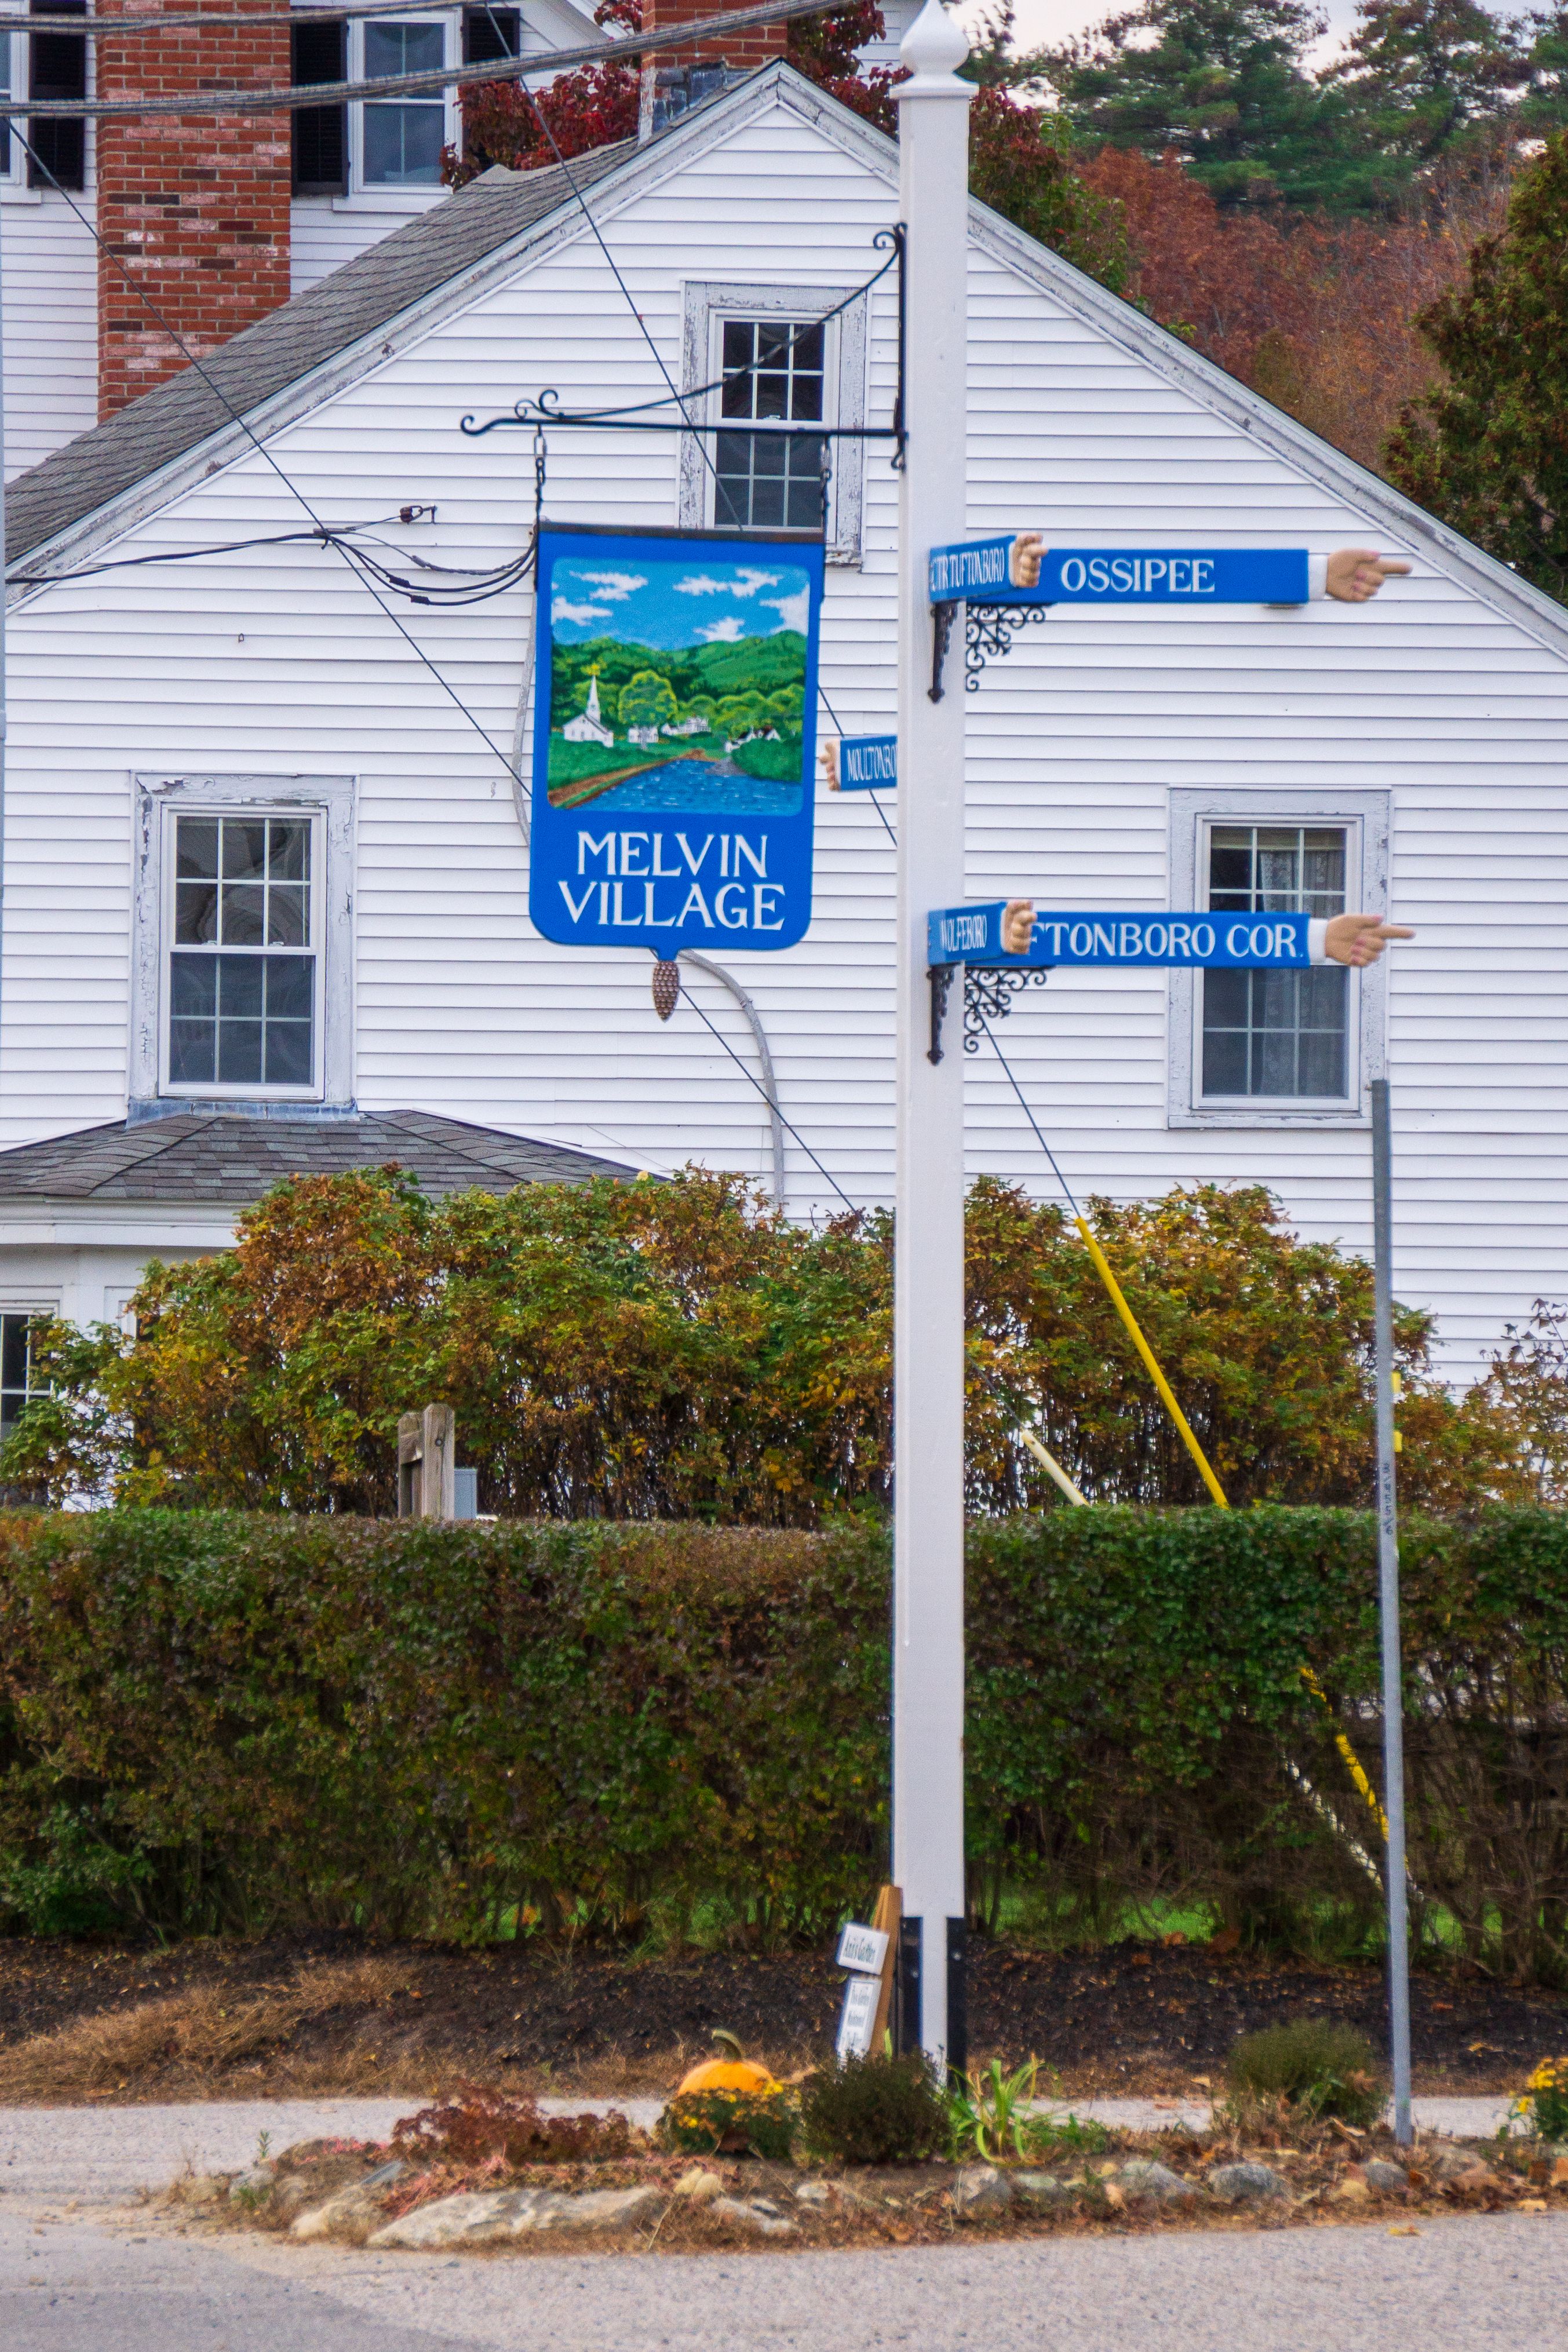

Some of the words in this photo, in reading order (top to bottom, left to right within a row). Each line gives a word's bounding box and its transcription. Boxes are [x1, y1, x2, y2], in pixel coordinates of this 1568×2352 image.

[950, 547, 1005, 588] TUFTONBORO
[1060, 557, 1216, 593] OSSIPEE
[577, 831, 768, 878] MELVIN
[558, 880, 786, 931] VILLAGE
[940, 914, 987, 951] WOLFEBORO
[1226, 923, 1304, 958] COR.
